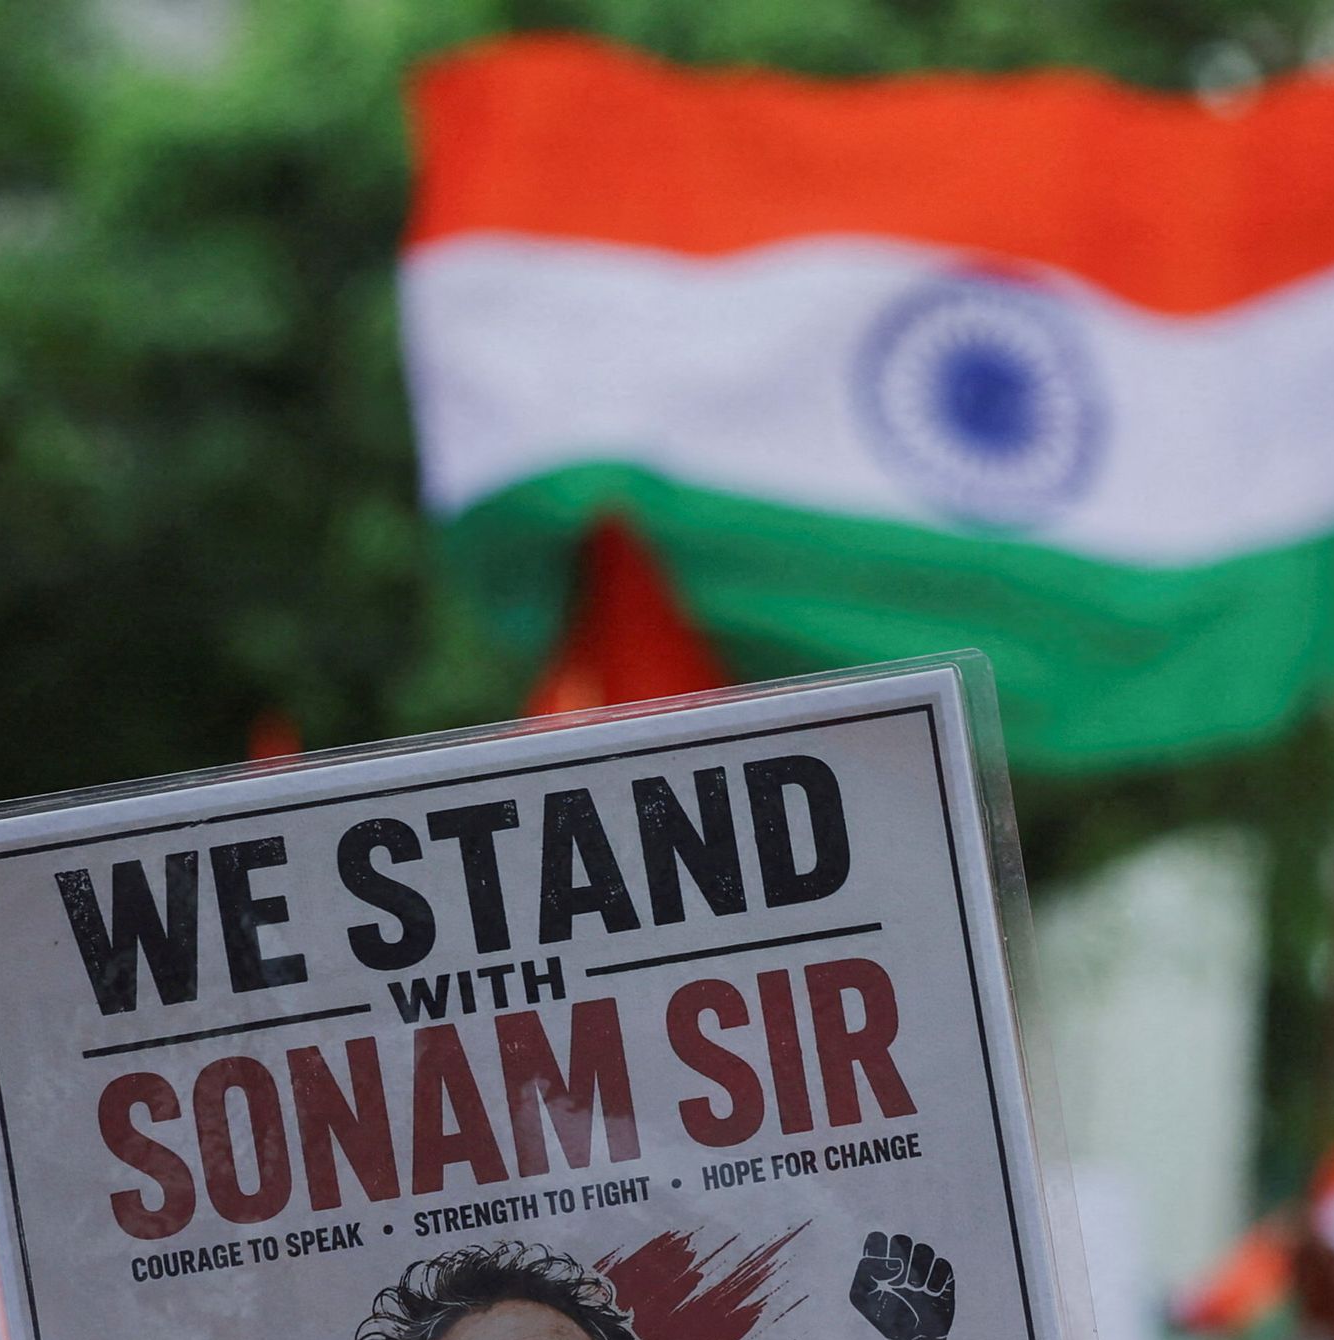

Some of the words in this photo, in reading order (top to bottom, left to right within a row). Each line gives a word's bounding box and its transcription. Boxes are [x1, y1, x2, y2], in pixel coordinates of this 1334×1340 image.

[54, 835, 308, 1015] WE
[337, 754, 851, 972] STAND
[387, 956, 567, 1024] WITH
[97, 996, 642, 1240] SONAM
[665, 957, 916, 1148] SIR
[131, 1241, 244, 1282] COURAGE
[252, 1236, 280, 1263] TO
[286, 1222, 364, 1257] SPEAK
[414, 1194, 539, 1237] STRENGTH
[544, 1189, 574, 1216] TO
[583, 1176, 650, 1210] FIGHT
[702, 1157, 766, 1191] HOPE
[771, 1150, 818, 1180] FOR
[825, 1133, 922, 1171] CHANGE
